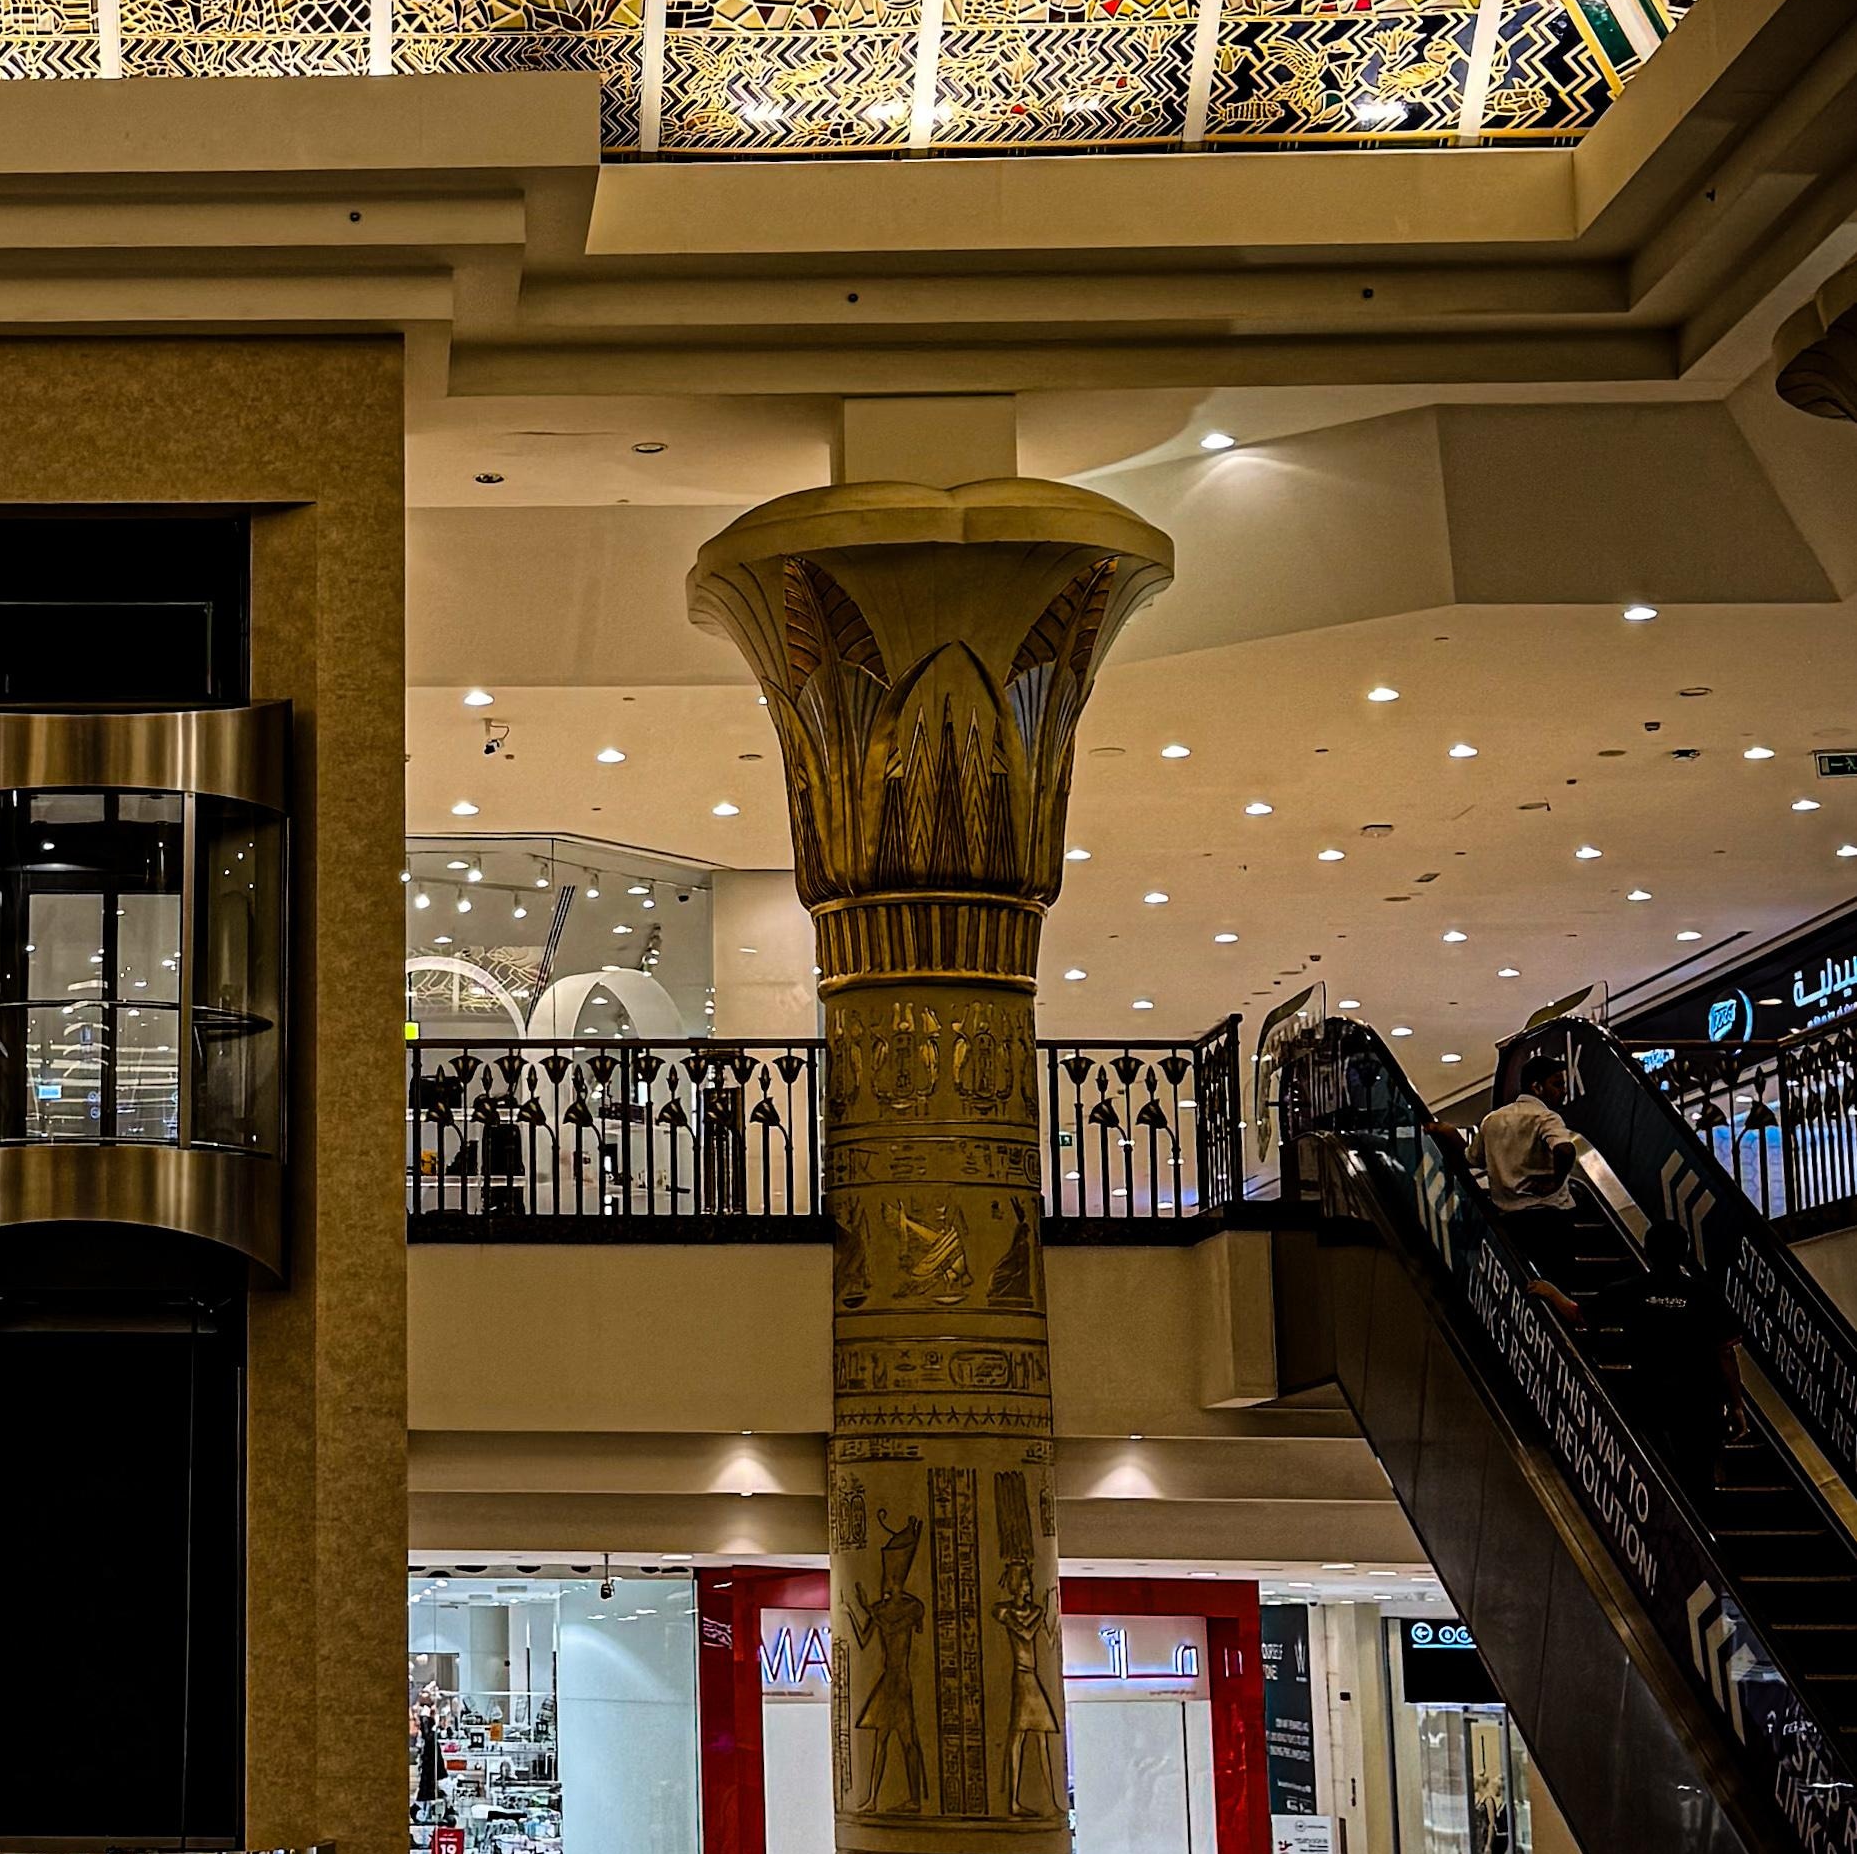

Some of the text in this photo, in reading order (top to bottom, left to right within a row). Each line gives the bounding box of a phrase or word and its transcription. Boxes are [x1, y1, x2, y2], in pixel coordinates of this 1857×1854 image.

[1793, 957, 1857, 1008] يدلية
[1477, 1238, 1650, 1523] STEP RIGHT THIS WAY TO
[1725, 1267, 1827, 1429] LINK'S RETAIL
[1738, 1236, 1776, 1299] STEP
[1778, 1285, 1831, 1373] RIGHT
[1467, 1268, 1658, 1597] LINK'S RETAIL REVOLUTION!
